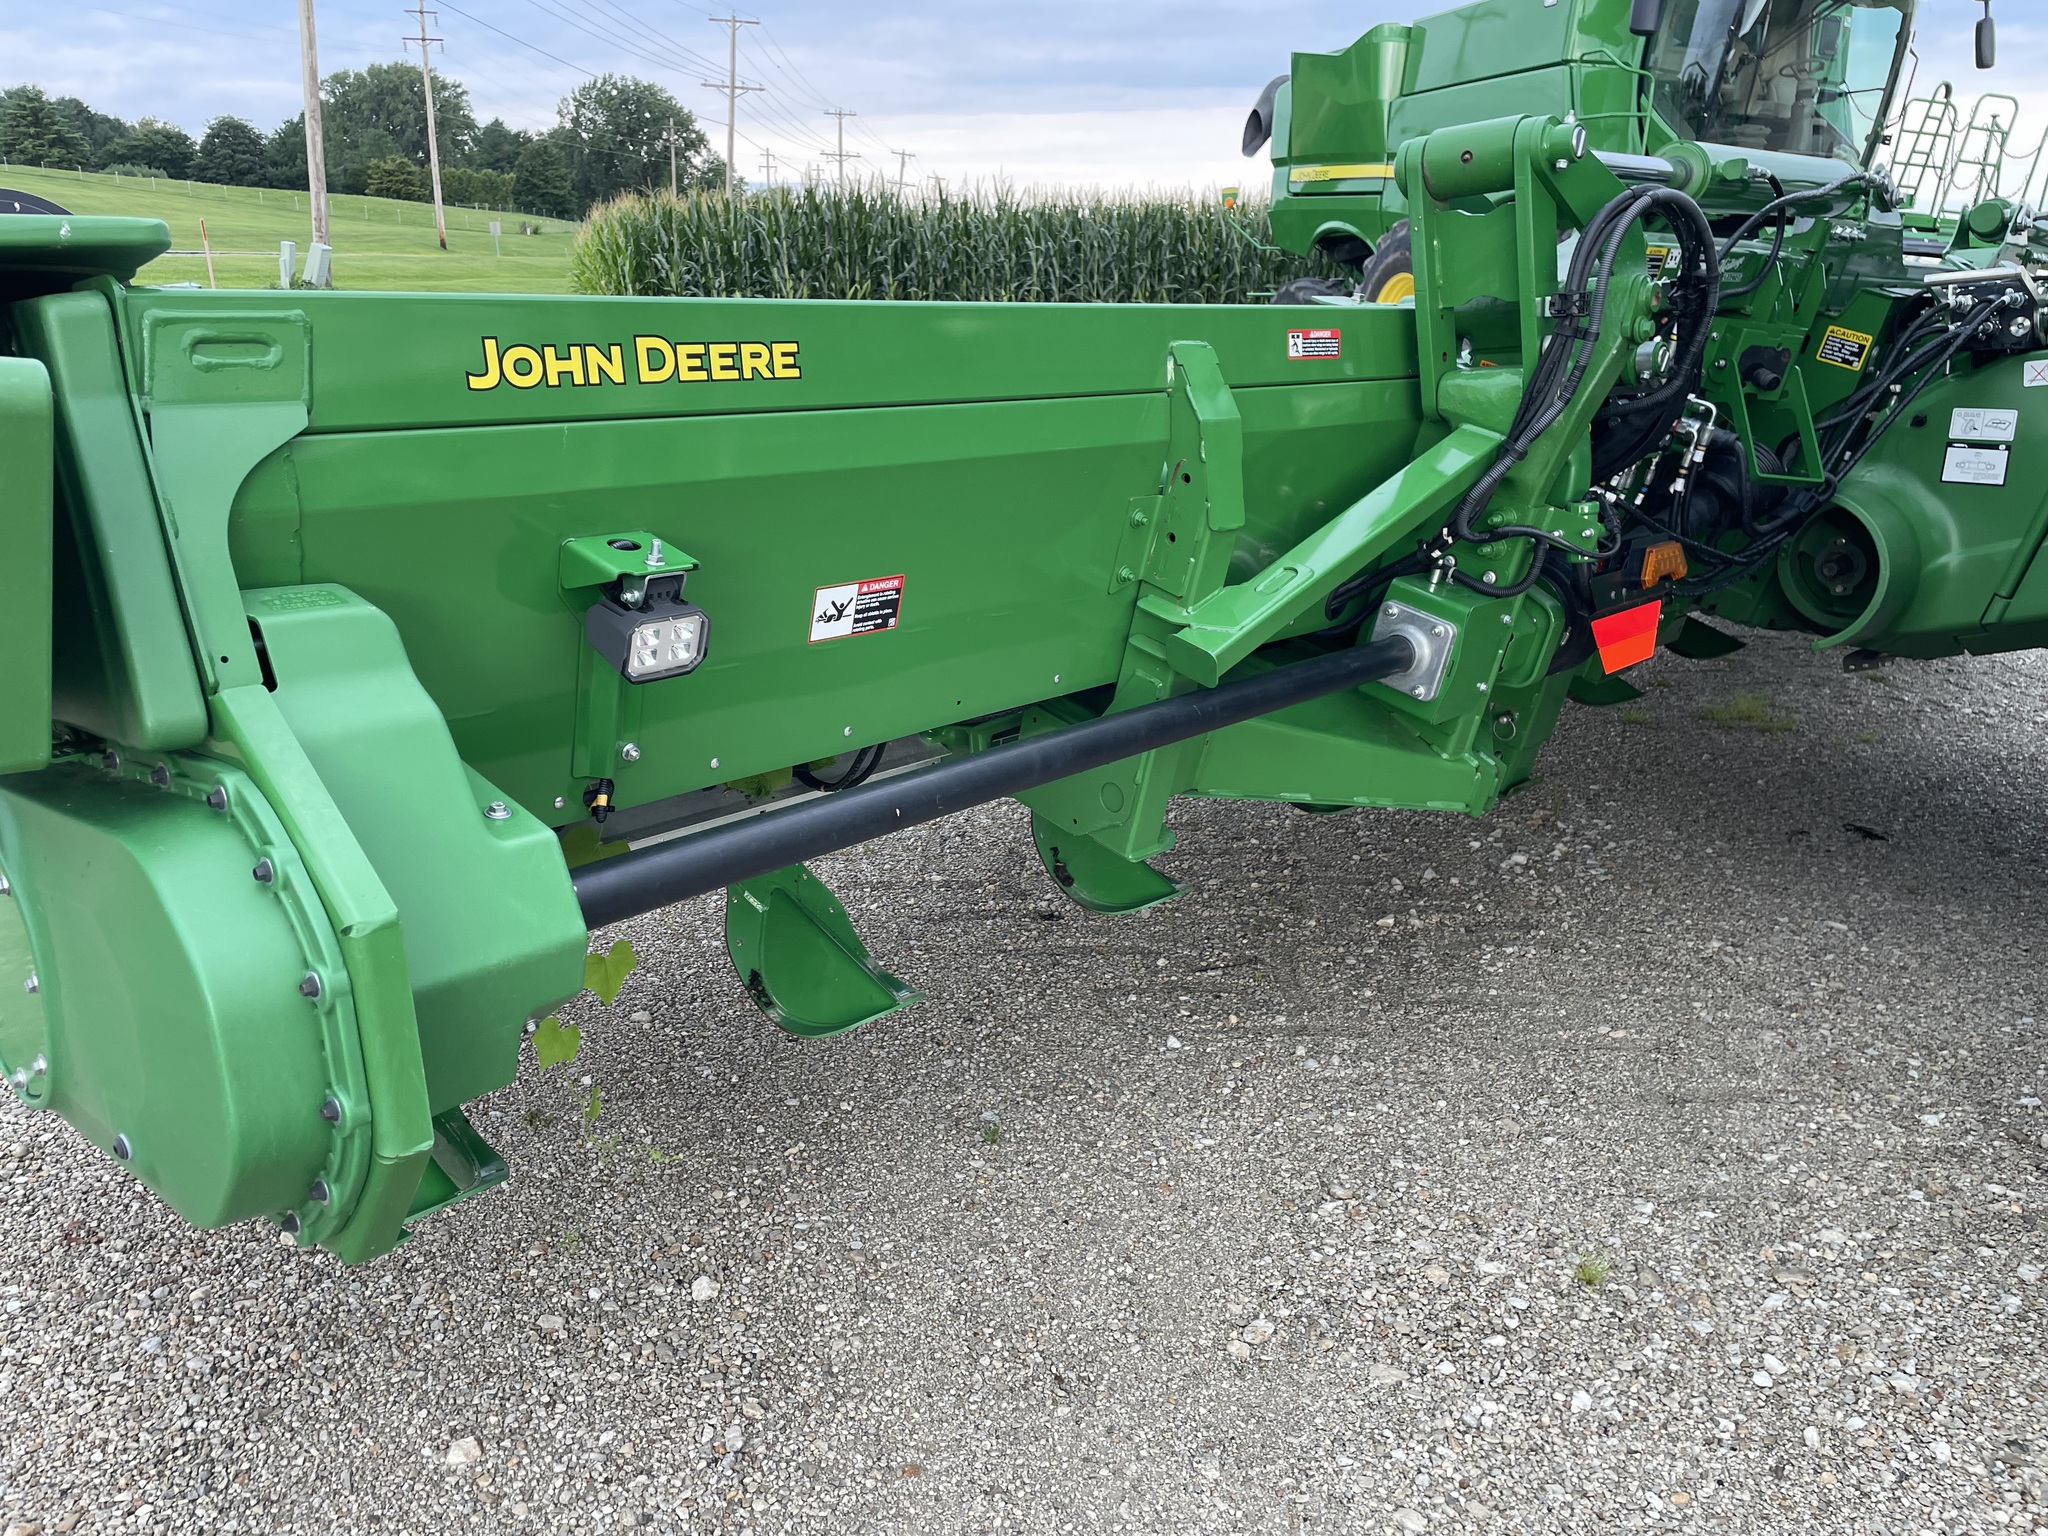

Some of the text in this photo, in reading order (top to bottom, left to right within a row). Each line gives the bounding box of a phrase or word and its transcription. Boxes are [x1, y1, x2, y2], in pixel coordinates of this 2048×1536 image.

[1835, 329, 1870, 344] CAUTION
[465, 334, 802, 391] JOHN DEERE
[870, 579, 899, 591] DANGER
